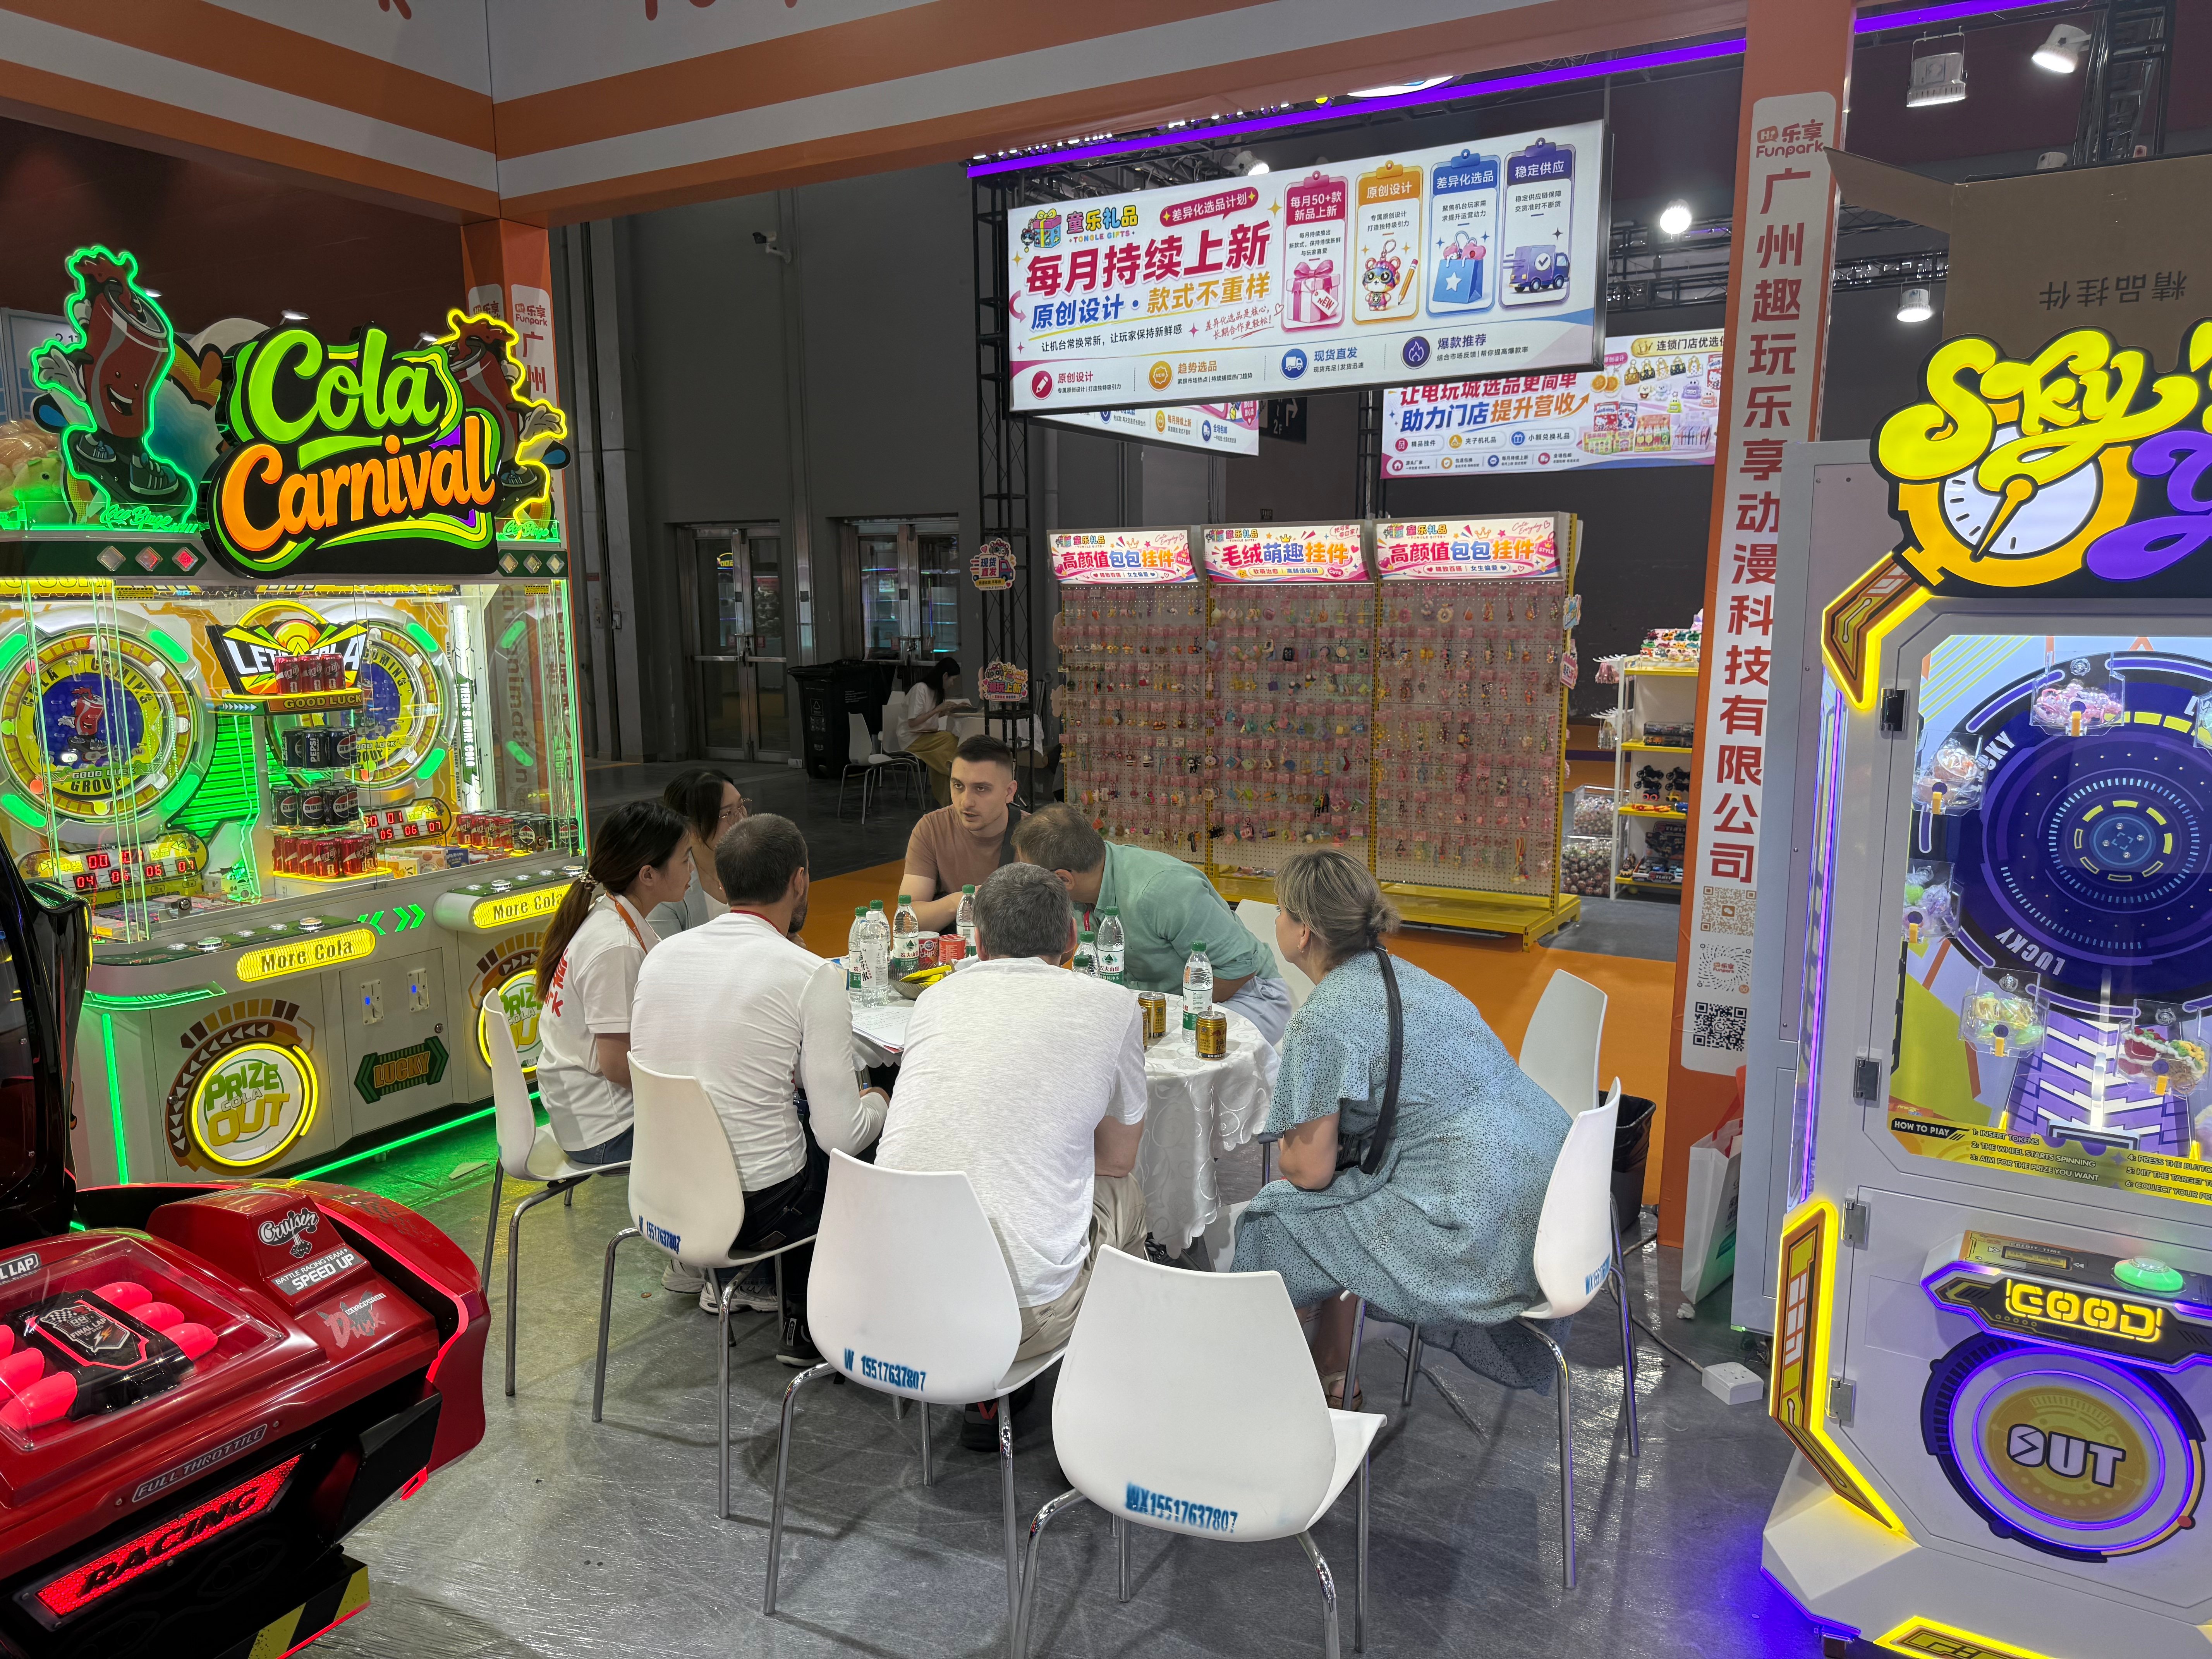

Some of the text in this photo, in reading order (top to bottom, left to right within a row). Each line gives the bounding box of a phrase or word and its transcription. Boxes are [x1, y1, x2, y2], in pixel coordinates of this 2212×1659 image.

[1782, 119, 1823, 143] 乐享
[1756, 140, 1823, 158] Funpark
[1515, 160, 1565, 179] 稳定供应
[1436, 170, 1494, 189] 差异化选品
[1290, 192, 1342, 208] 每月50+款
[1366, 183, 1412, 199] 原创设计
[1515, 191, 1562, 203] 稳定供应链保障
[1172, 195, 1247, 222] 差异化选品计划
[1294, 205, 1338, 221] 新品上新
[1442, 200, 1487, 211] 聚焦机台玩家需
[1515, 201, 1561, 213] 交货准时不断货
[1066, 205, 1138, 234] 童乐礼品
[1370, 210, 1407, 221] 专属原创设计
[1442, 210, 1487, 222] 求提升运营动力
[1367, 220, 1409, 231] 打造独特吸引力
[1073, 230, 1130, 244] TONGLE GIFTS
[1026, 220, 1271, 296] 每月持续上新
[2039, 270, 2188, 310] 精品挂件
[527, 304, 546, 318] 乐享
[1317, 294, 1335, 310] NEW
[516, 313, 547, 326] Funpark
[1437, 333, 1487, 350] 爆款推荐
[1314, 347, 1358, 361] 现货直发
[1177, 360, 1217, 374] 趋势选品
[249, 328, 439, 443] Cola
[1057, 371, 1094, 384] 原创设计
[1400, 373, 1578, 407] 让电玩城选品更简单
[1400, 392, 1575, 433] 助力门店提升营收
[1878, 321, 2212, 492] Sky'
[1465, 436, 1496, 445] 夹子机礼品
[1528, 433, 1570, 442] 小额兑换礼品
[222, 416, 495, 551] Carnival
[1226, 529, 1259, 539] 童乐礼品
[1406, 525, 1447, 535] 童乐礼品
[1710, 168, 1811, 883] 广州趣玩乐享动漫科技有限公司
[1073, 535, 1105, 545] 童乐礼品
[1061, 549, 1175, 571] 高颜值包包挂件
[1221, 542, 1348, 567] 毛绒萌趣挂件
[1389, 540, 1535, 564] 高颜值包包挂件
[284, 694, 362, 709] GOOD LUCK
[460, 682, 476, 767] THERE'S MORE COLA
[72, 770, 102, 779] GOOD
[70, 776, 121, 793] GROUP
[380, 828, 393, 841] 05
[405, 825, 418, 836] 06
[429, 821, 441, 833] 07
[88, 854, 108, 869] 00
[146, 864, 162, 877] 06
[77, 875, 94, 888] 04
[493, 892, 563, 921] More Cola
[261, 939, 354, 972] More Cola
[1995, 927, 2066, 975] LUCKY
[374, 1052, 431, 1088] LUCKY
[205, 1062, 280, 1112] PRIZE
[221, 1088, 263, 1112] COLA
[208, 1093, 291, 1147] OUT
[1894, 1120, 1915, 1131] HOW
[1917, 1123, 1928, 1132] TO
[1979, 1129, 2006, 1140] INSERT
[2008, 1133, 2040, 1146] TOKENS
[1972, 1141, 2096, 1168] 2: THE WHEEL STARTS SPINNING
[2128, 1153, 2136, 1161] 4:
[2138, 1155, 2164, 1166] PRESS
[2166, 1158, 2182, 1169] THE
[1979, 1155, 1995, 1164] AIM
[1997, 1158, 2013, 1167] FOR
[2014, 1160, 2029, 1170] THE
[2030, 1162, 2055, 1174] PRIZE
[2056, 1166, 2073, 1176] YOU
[2074, 1168, 2100, 1182] WANT
[2126, 1166, 2135, 1175] 5:
[2137, 1168, 2150, 1178] HIT
[2152, 1170, 2169, 1181] THE
[2171, 1173, 2202, 1185] TARGET
[2125, 1180, 2197, 1198] 6: COLLECT YOUR
[10, 1257, 34, 1276] LAP
[275, 1269, 302, 1285] BATTLE
[301, 1257, 327, 1273] RACING
[292, 1253, 355, 1291] SPEED UP
[346, 1293, 386, 1316] MEGAPHONE
[2011, 1282, 2155, 1340] GOOD
[70, 1318, 107, 1340] FINAL LAP
[861, 1355, 927, 1392] 15517637807
[137, 1429, 264, 1497] FULL THROTTLE
[2007, 1424, 2126, 1488] OUT
[79, 1486, 260, 1596] RACING
